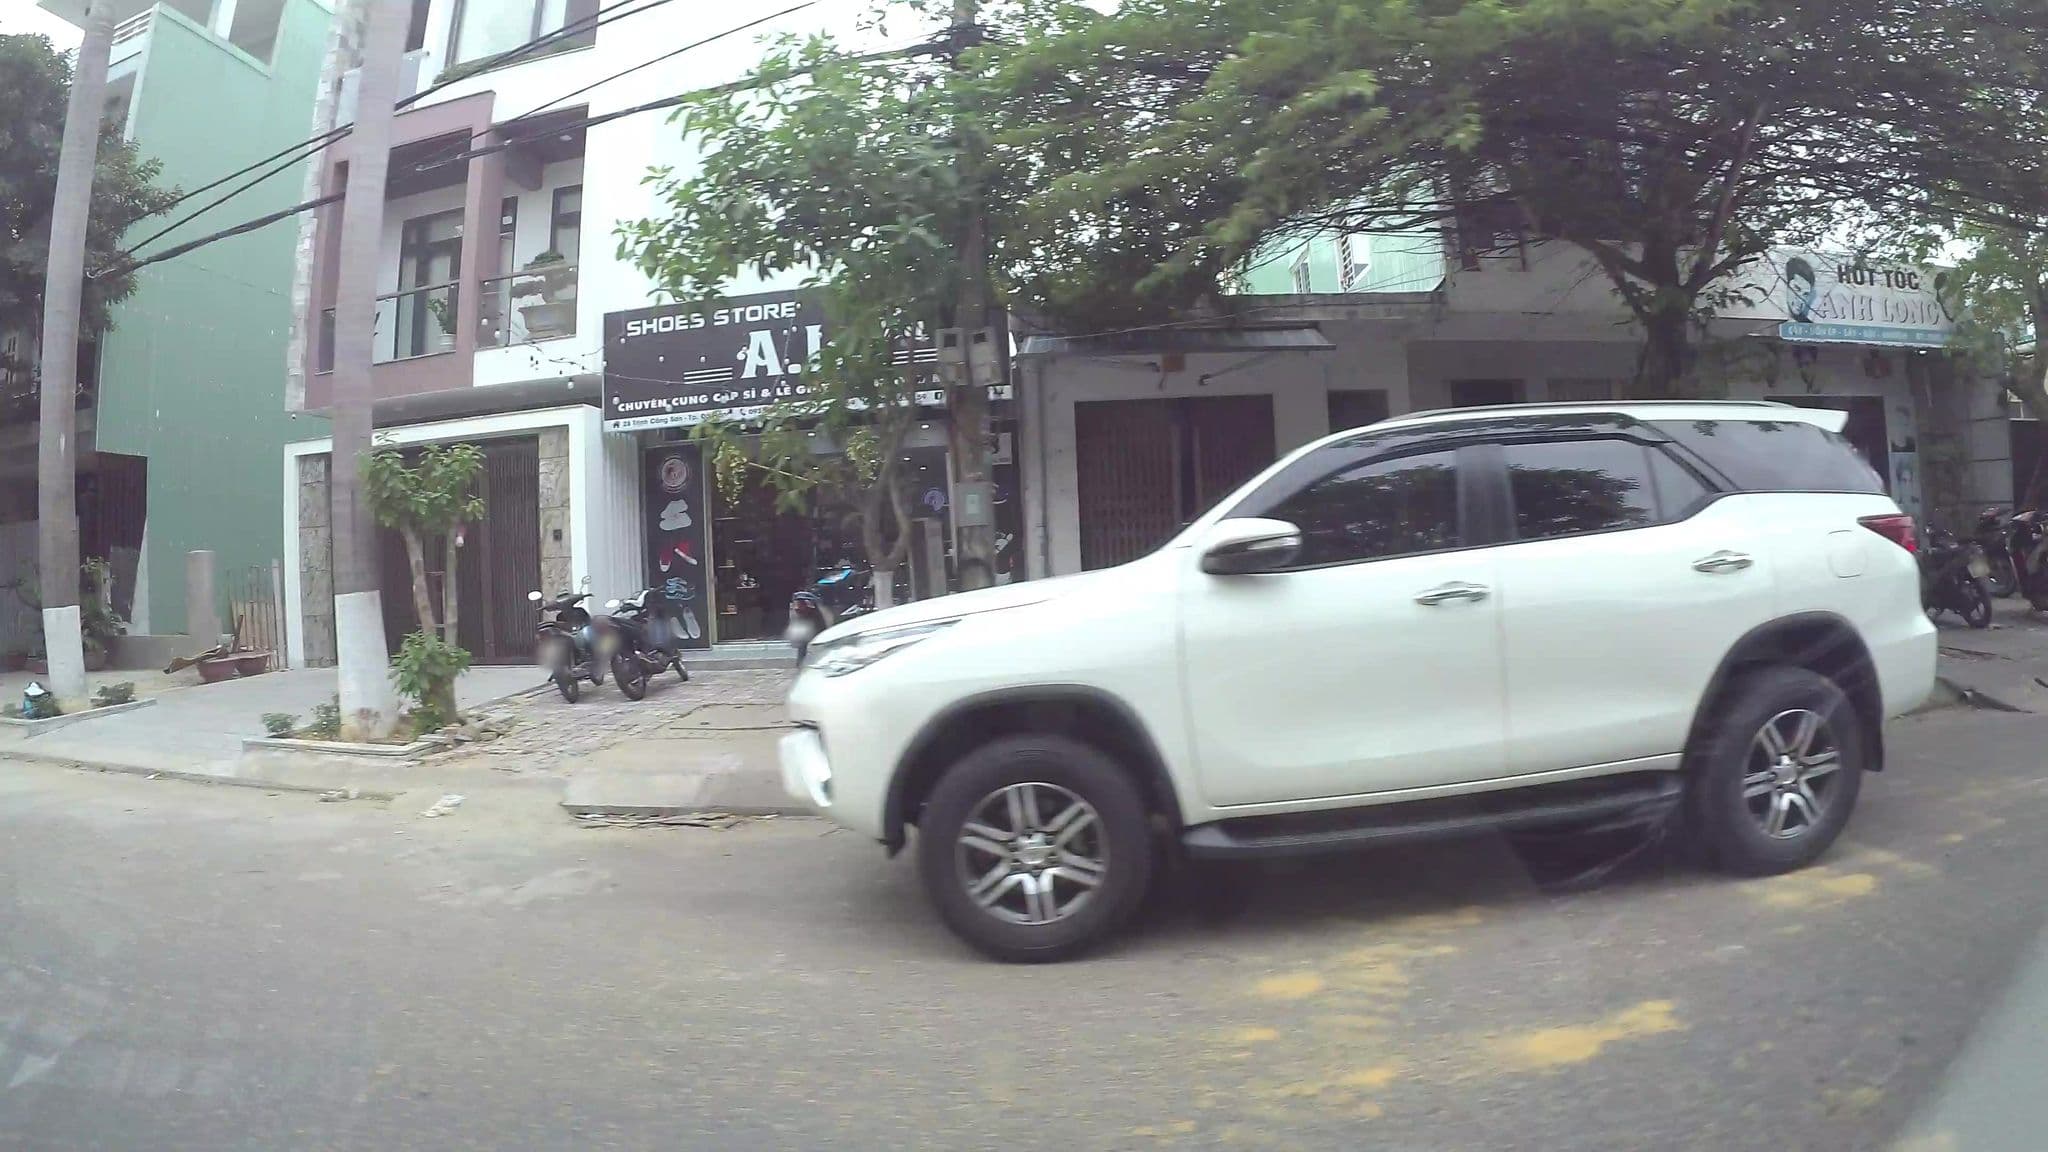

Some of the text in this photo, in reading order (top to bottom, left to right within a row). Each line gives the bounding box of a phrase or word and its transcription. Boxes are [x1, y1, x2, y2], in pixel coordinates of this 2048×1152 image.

[627, 302, 796, 337] SHOES STORE
[1881, 297, 1940, 325] LONG
[617, 398, 666, 412] CHUYÊN
[672, 394, 709, 407] CUNG
